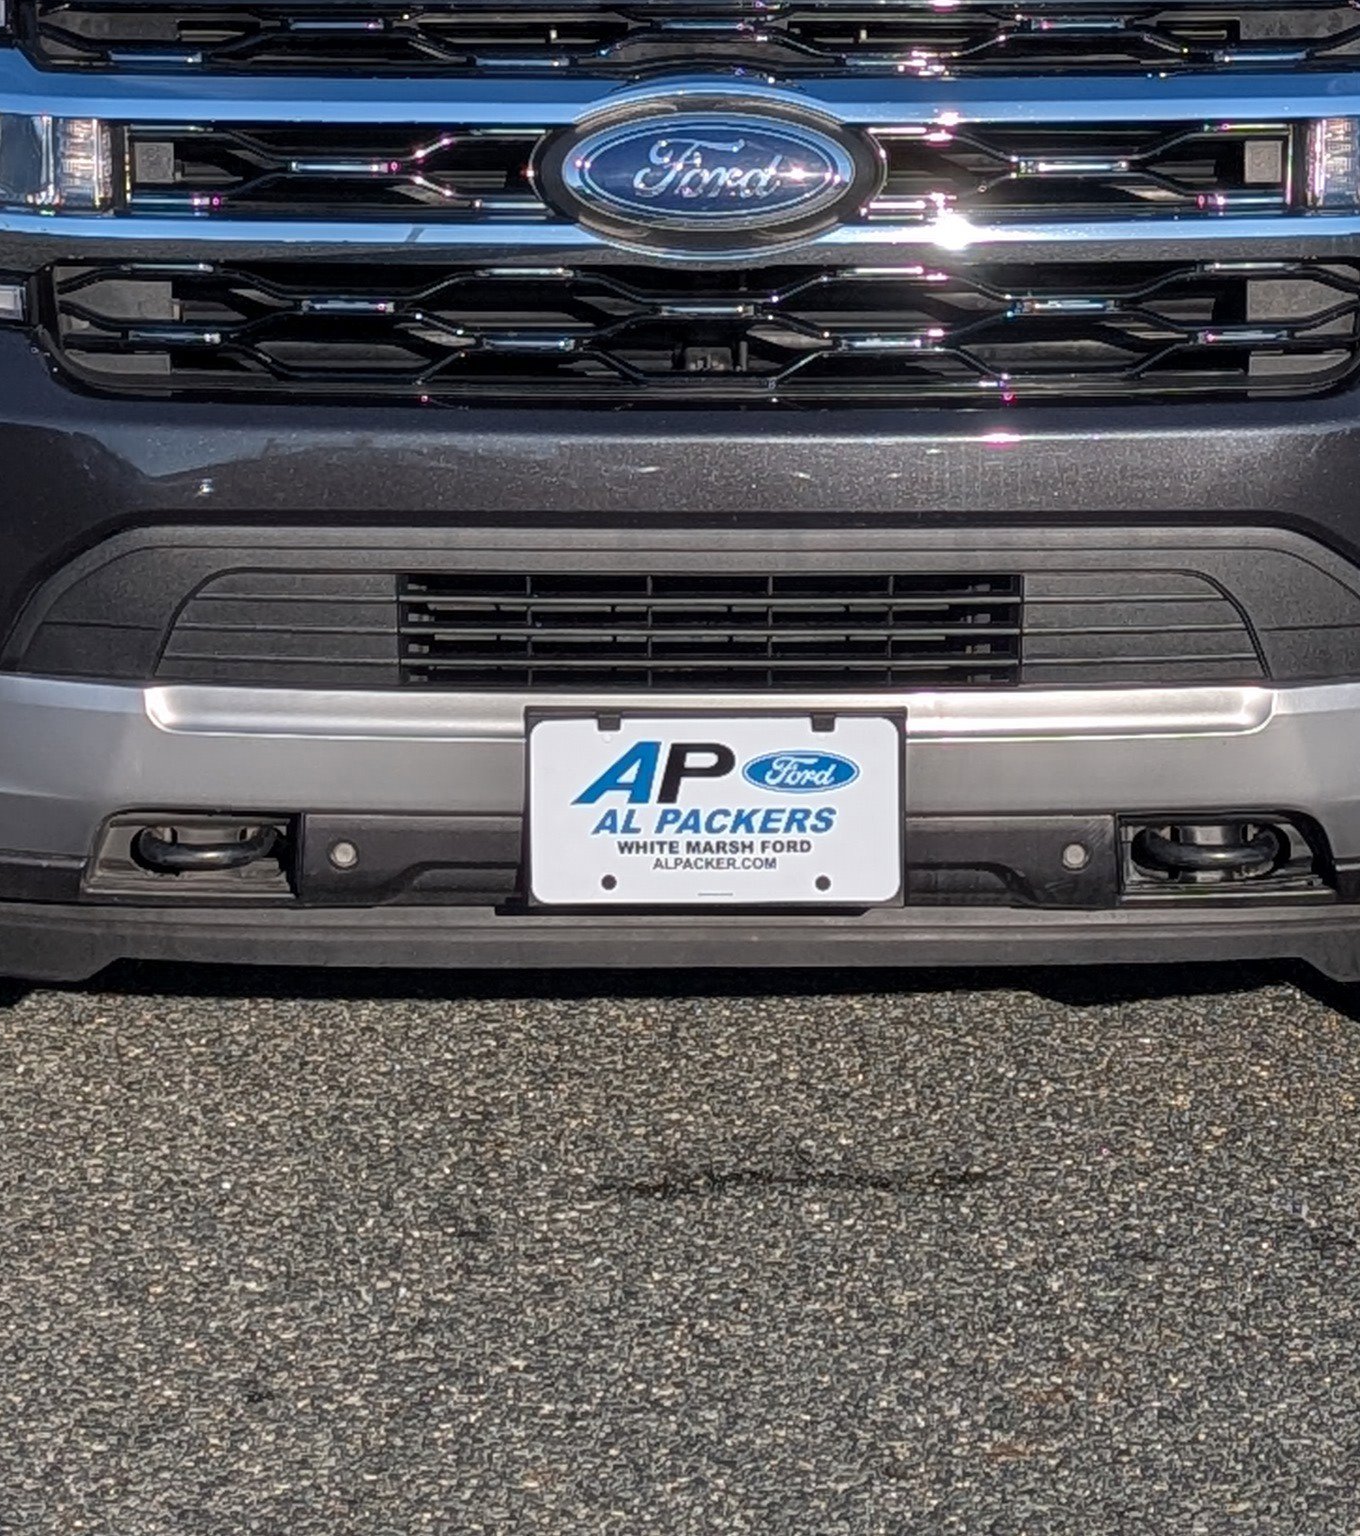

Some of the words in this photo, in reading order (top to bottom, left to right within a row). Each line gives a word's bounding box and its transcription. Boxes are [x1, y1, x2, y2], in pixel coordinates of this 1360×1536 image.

[632, 137, 783, 199] Ford
[571, 740, 736, 806] AP
[764, 756, 835, 786] Ford
[591, 808, 642, 835] AL
[654, 807, 837, 835] PACKERS
[617, 840, 680, 855] WHITE
[686, 840, 754, 854] MARSH
[761, 839, 812, 854] FORD
[652, 857, 777, 870] ALPACKER.COM
